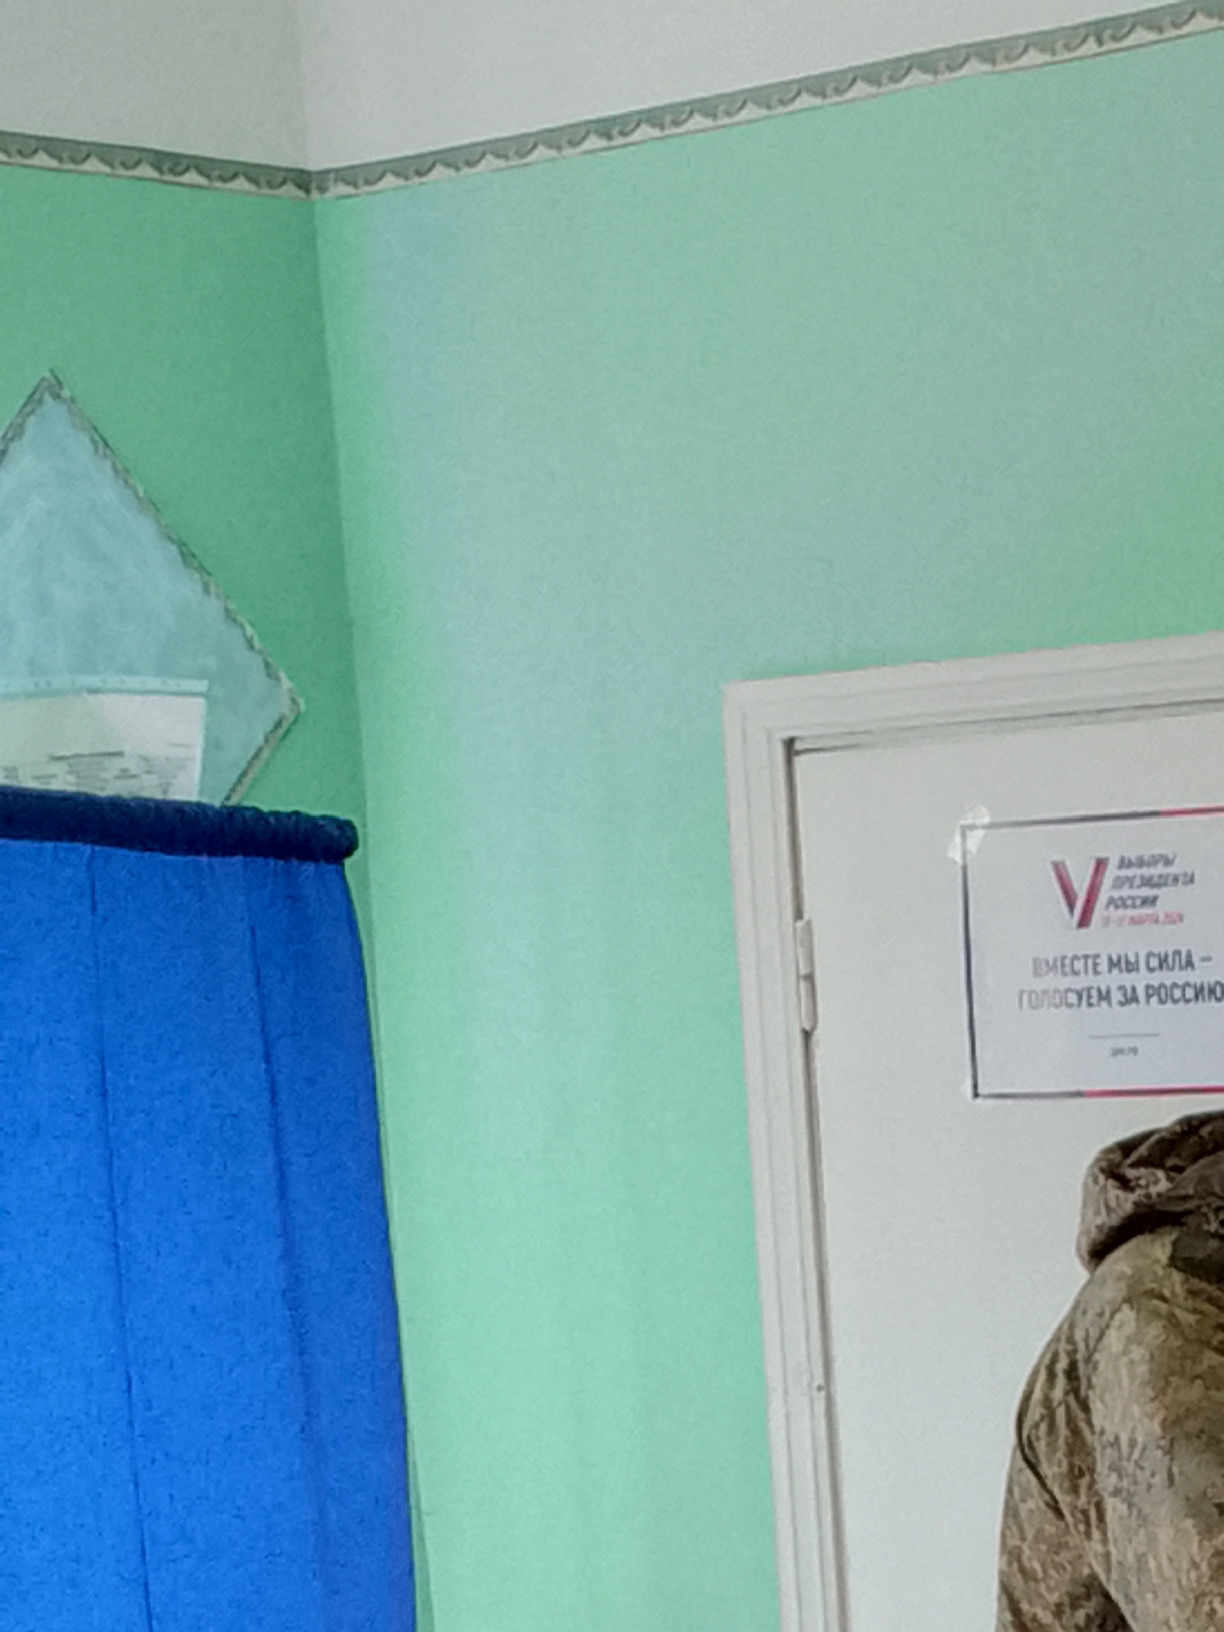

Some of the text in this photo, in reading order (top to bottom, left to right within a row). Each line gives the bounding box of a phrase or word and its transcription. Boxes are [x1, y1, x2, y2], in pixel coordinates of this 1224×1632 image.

[1031, 953, 1102, 979] ВМЕСТЕ
[1107, 951, 1140, 974] МЫ
[1145, 949, 1196, 972] СИЛА
[1017, 984, 1113, 1011] ГОЛОСУЕМ
[1117, 984, 1141, 1007] ЗА
